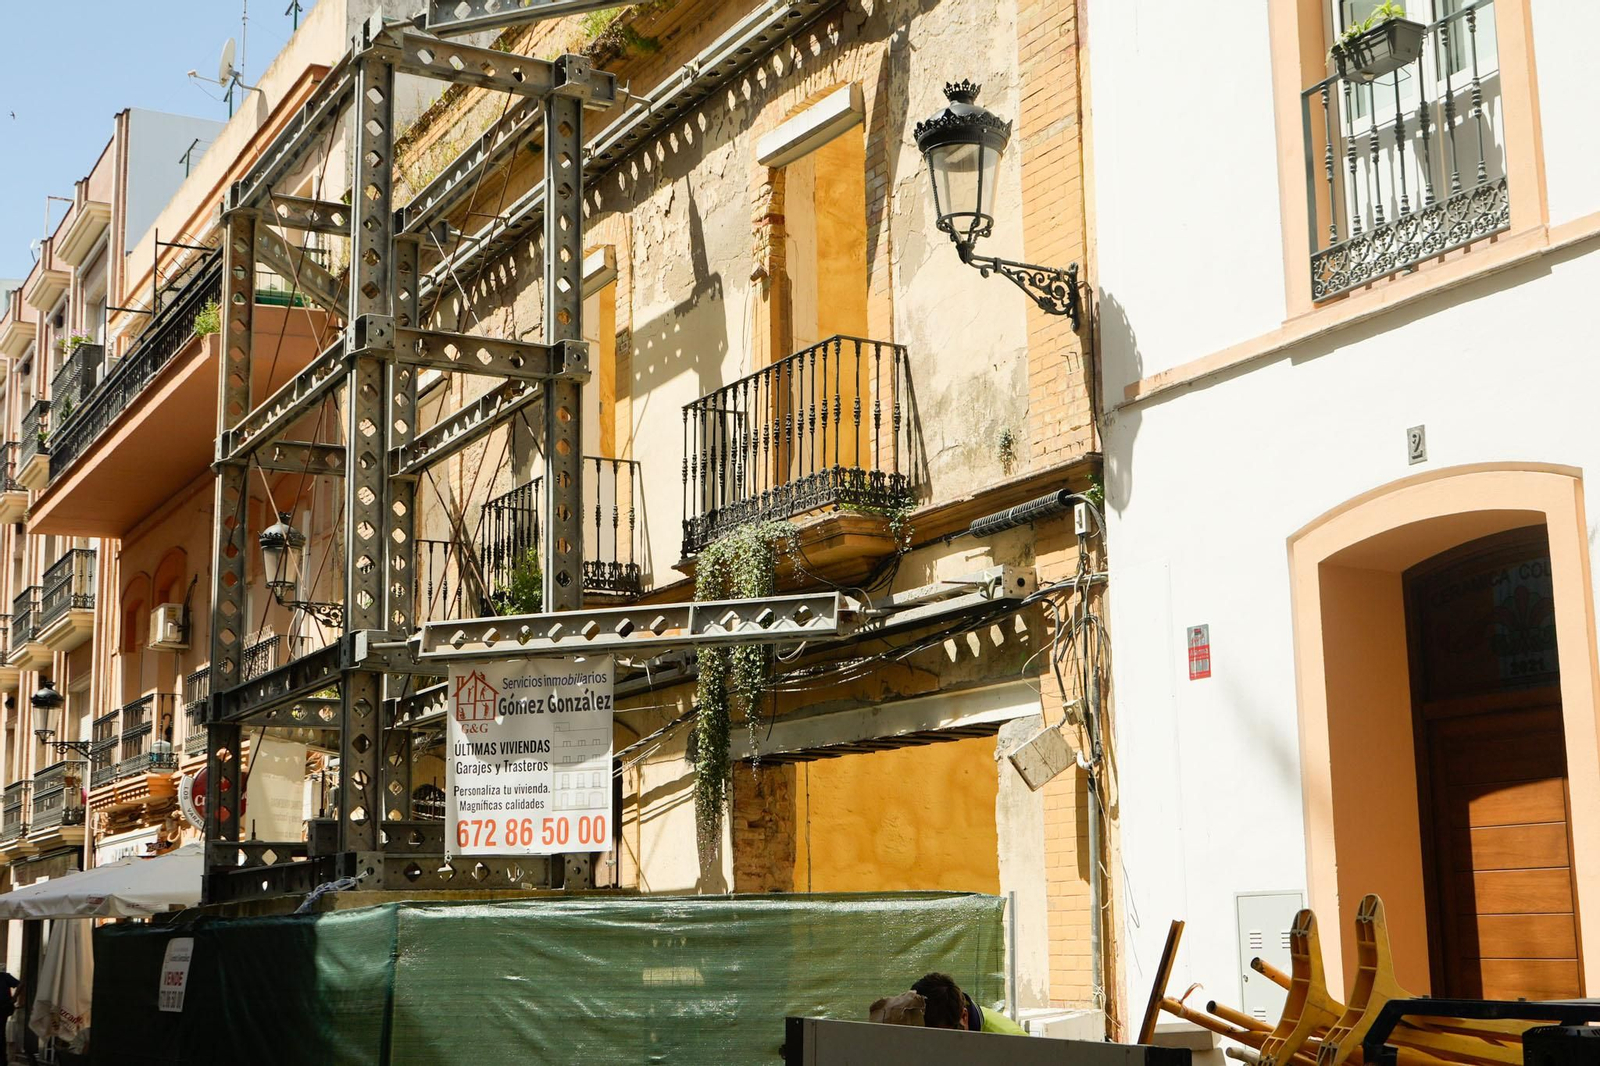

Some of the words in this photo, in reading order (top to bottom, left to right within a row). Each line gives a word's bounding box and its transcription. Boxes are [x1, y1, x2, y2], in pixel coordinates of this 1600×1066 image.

[1412, 433, 1424, 460] 2
[502, 676, 543, 690] Servicios
[543, 671, 607, 687] inmobiliarios
[498, 693, 544, 716] Gómez
[547, 688, 611, 714] González
[461, 723, 488, 734] G&G
[454, 740, 497, 757] ÚLTIMAS
[500, 739, 550, 755] VIVIENDAS
[456, 761, 492, 776] Garajes
[495, 763, 501, 776] y
[504, 760, 548, 773] Trasteros
[453, 784, 501, 797] Personaliza
[503, 784, 512, 795] tu
[513, 782, 551, 795] vivienda.
[459, 798, 503, 813] Magníficas
[505, 798, 545, 811] calidades
[187, 807, 203, 827] VARAL
[457, 818, 497, 848] 672
[505, 818, 533, 847] 86
[542, 816, 569, 846] 50
[578, 815, 606, 845] 00
